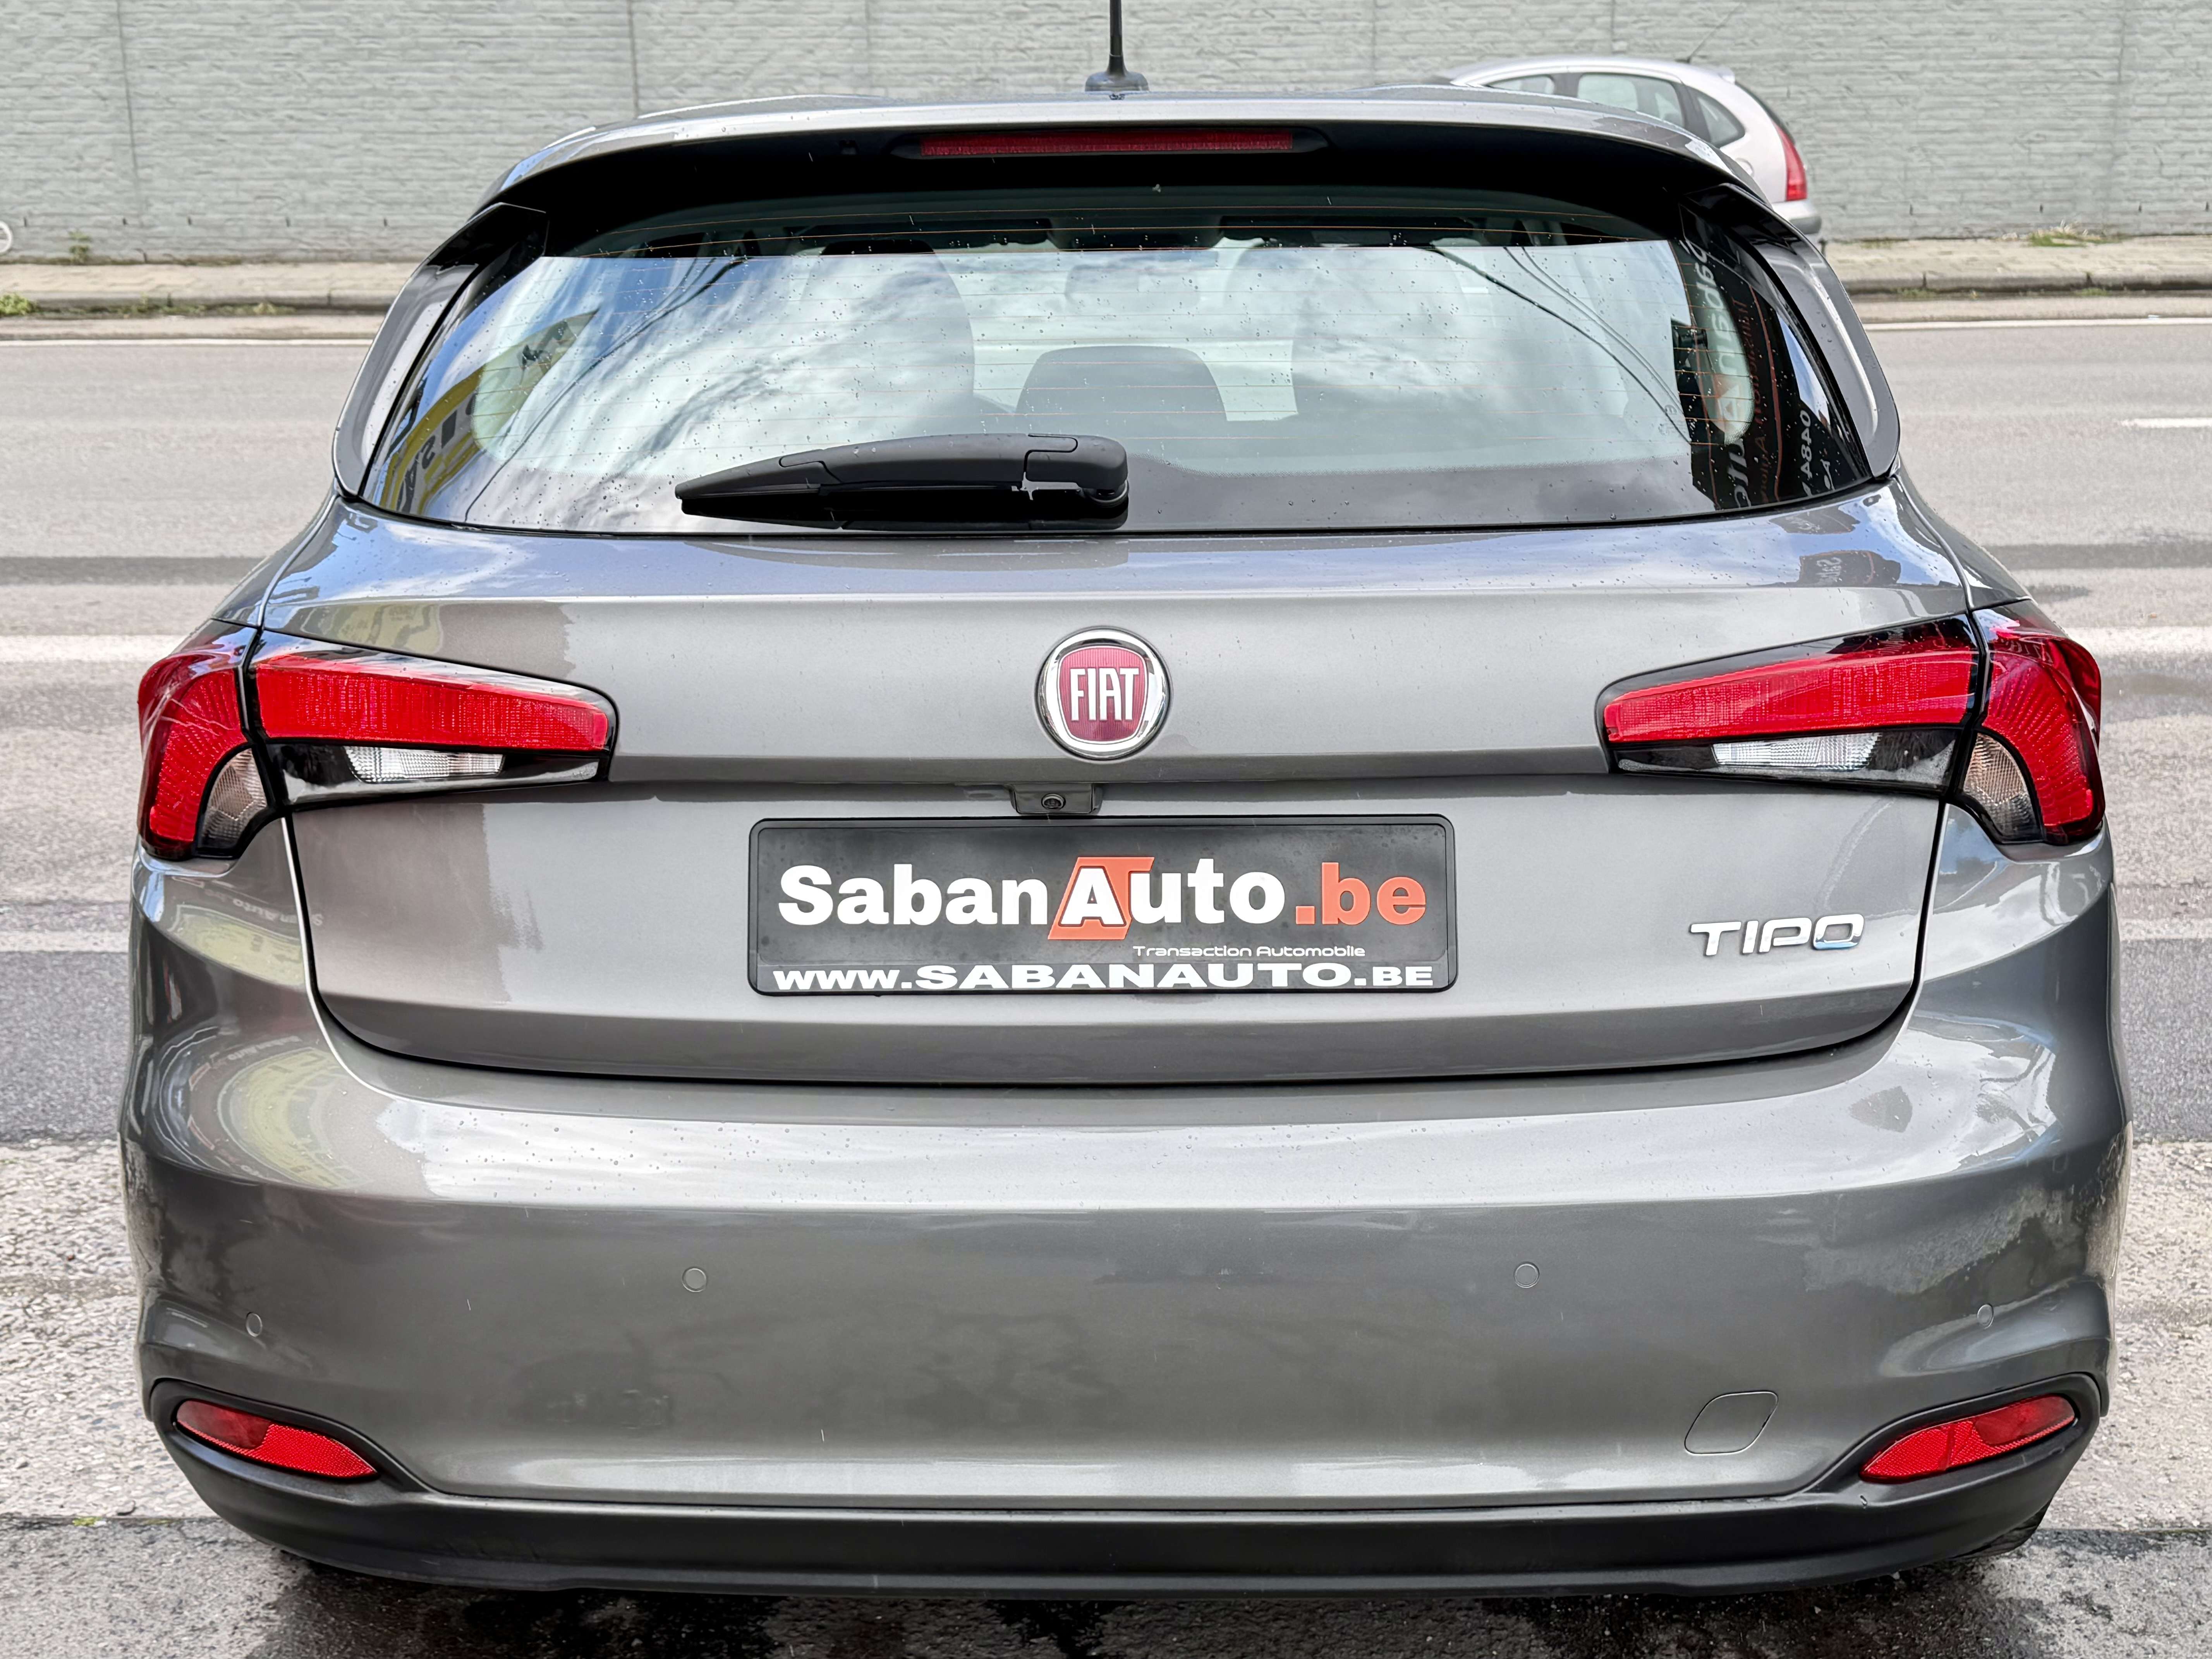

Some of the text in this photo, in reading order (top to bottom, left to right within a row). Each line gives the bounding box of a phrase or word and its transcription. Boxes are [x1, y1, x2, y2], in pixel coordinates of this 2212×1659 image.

[1070, 667, 1139, 721] FIAT
[1132, 945, 1366, 957] Transaction Automobile
[1690, 914, 1864, 956] TIPO
